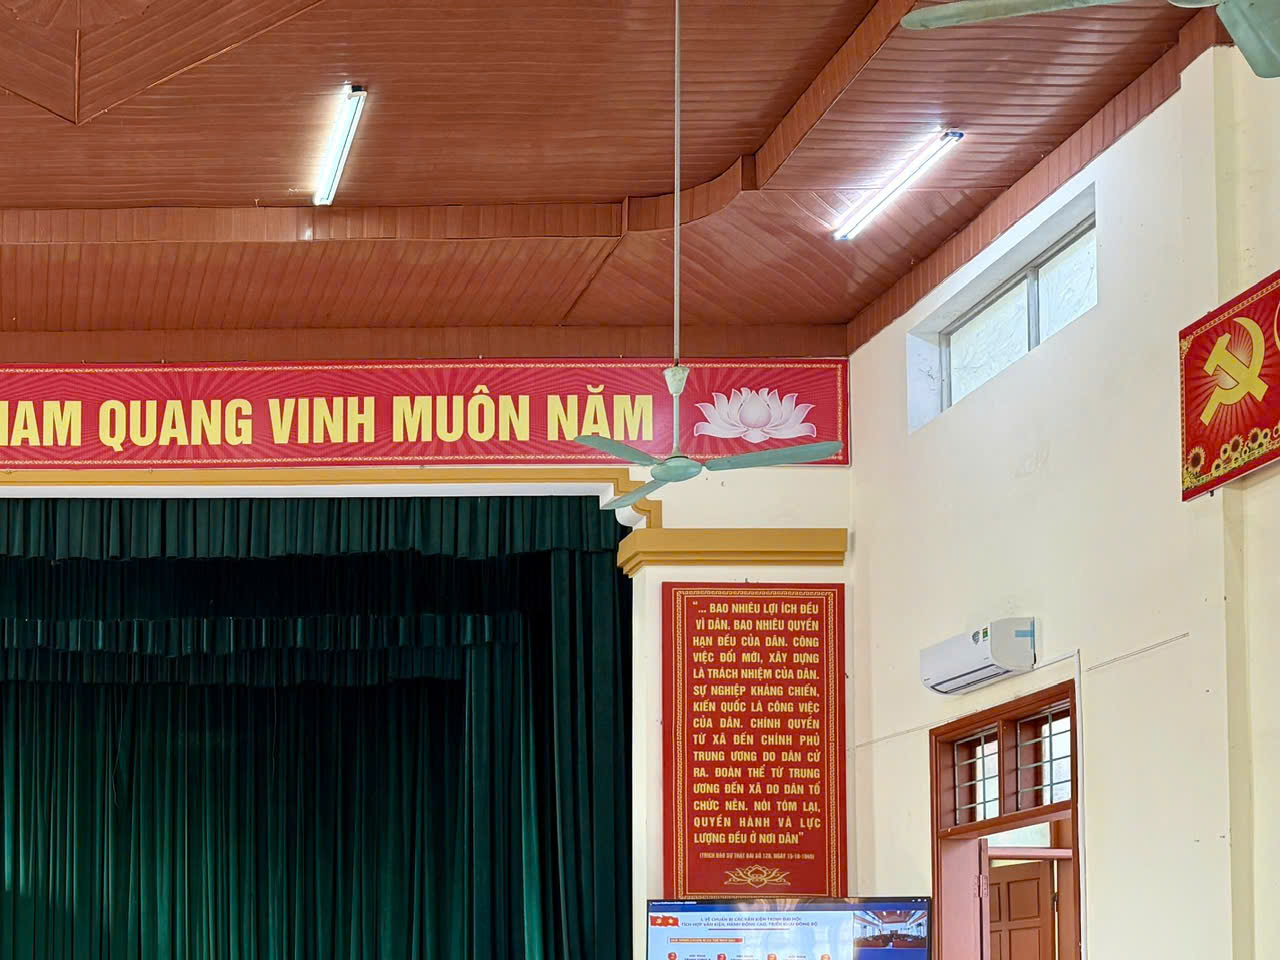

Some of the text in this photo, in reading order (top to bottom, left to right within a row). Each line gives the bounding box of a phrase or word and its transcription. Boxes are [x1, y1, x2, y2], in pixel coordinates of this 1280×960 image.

[98, 398, 253, 452] QUANG
[268, 395, 375, 444] VINH
[391, 384, 530, 443] MUÔN
[546, 384, 654, 442] NĂM
[709, 603, 729, 614] BAO
[731, 601, 760, 614] NHIÊU
[781, 601, 798, 614] ÍCH
[696, 617, 705, 630] VÌ
[733, 619, 753, 630] BAO
[755, 617, 785, 630] NHIÊU
[692, 636, 713, 649] HẠN
[741, 634, 760, 647] CỦA
[792, 634, 819, 647] CÔNG
[769, 650, 788, 663] XÂY
[693, 667, 705, 679] LÀ
[707, 667, 738, 679] TRÁCH
[774, 666, 794, 679] CỦA
[750, 683, 784, 696] KHÁNG
[751, 700, 763, 712] LÀ
[767, 700, 794, 712] CÔNG
[693, 716, 713, 728] CỦA
[750, 716, 781, 728] CHÍNH
[712, 732, 726, 745] XÃ
[761, 732, 792, 745] CHÍNH
[800, 732, 820, 745] PHỦ
[694, 751, 725, 762] TRUNG
[762, 751, 776, 762] DO
[781, 749, 802, 762] DÂN
[714, 766, 742, 778] ĐOÀN
[788, 768, 820, 778] TRUNG
[748, 782, 762, 795] XÃ
[766, 784, 780, 795] DO
[784, 782, 804, 795] DÂN
[754, 799, 771, 811] NÓI
[776, 799, 798, 811] TÓM
[739, 815, 770, 828] HÀNH
[778, 815, 792, 828] VÀ
[759, 833, 776, 844] NƠI
